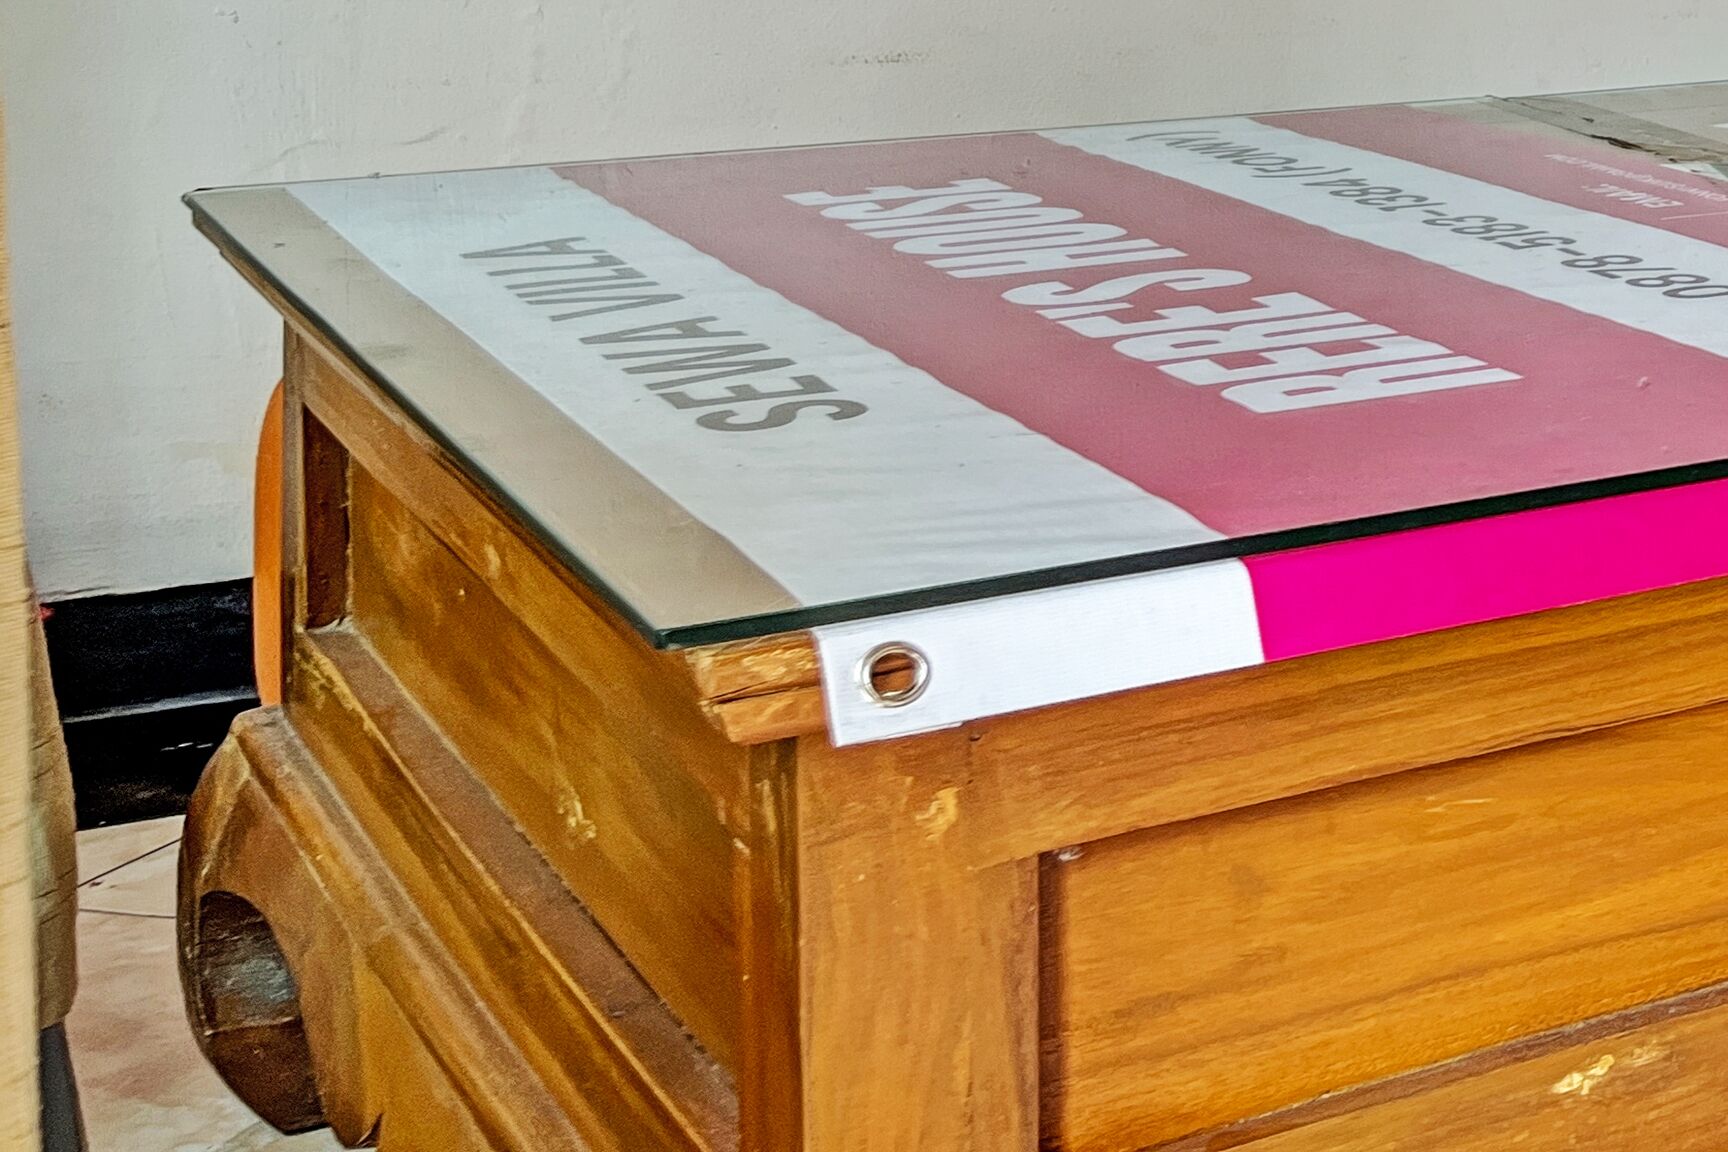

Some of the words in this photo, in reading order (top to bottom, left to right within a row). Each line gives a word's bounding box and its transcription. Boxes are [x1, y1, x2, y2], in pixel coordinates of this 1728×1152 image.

[1125, 130, 1353, 178] (FONNY)
[459, 236, 685, 322] VILLA
[782, 177, 1190, 279] HOUSE
[578, 315, 870, 432] SEWA
[1000, 267, 1526, 414] RERE'S
